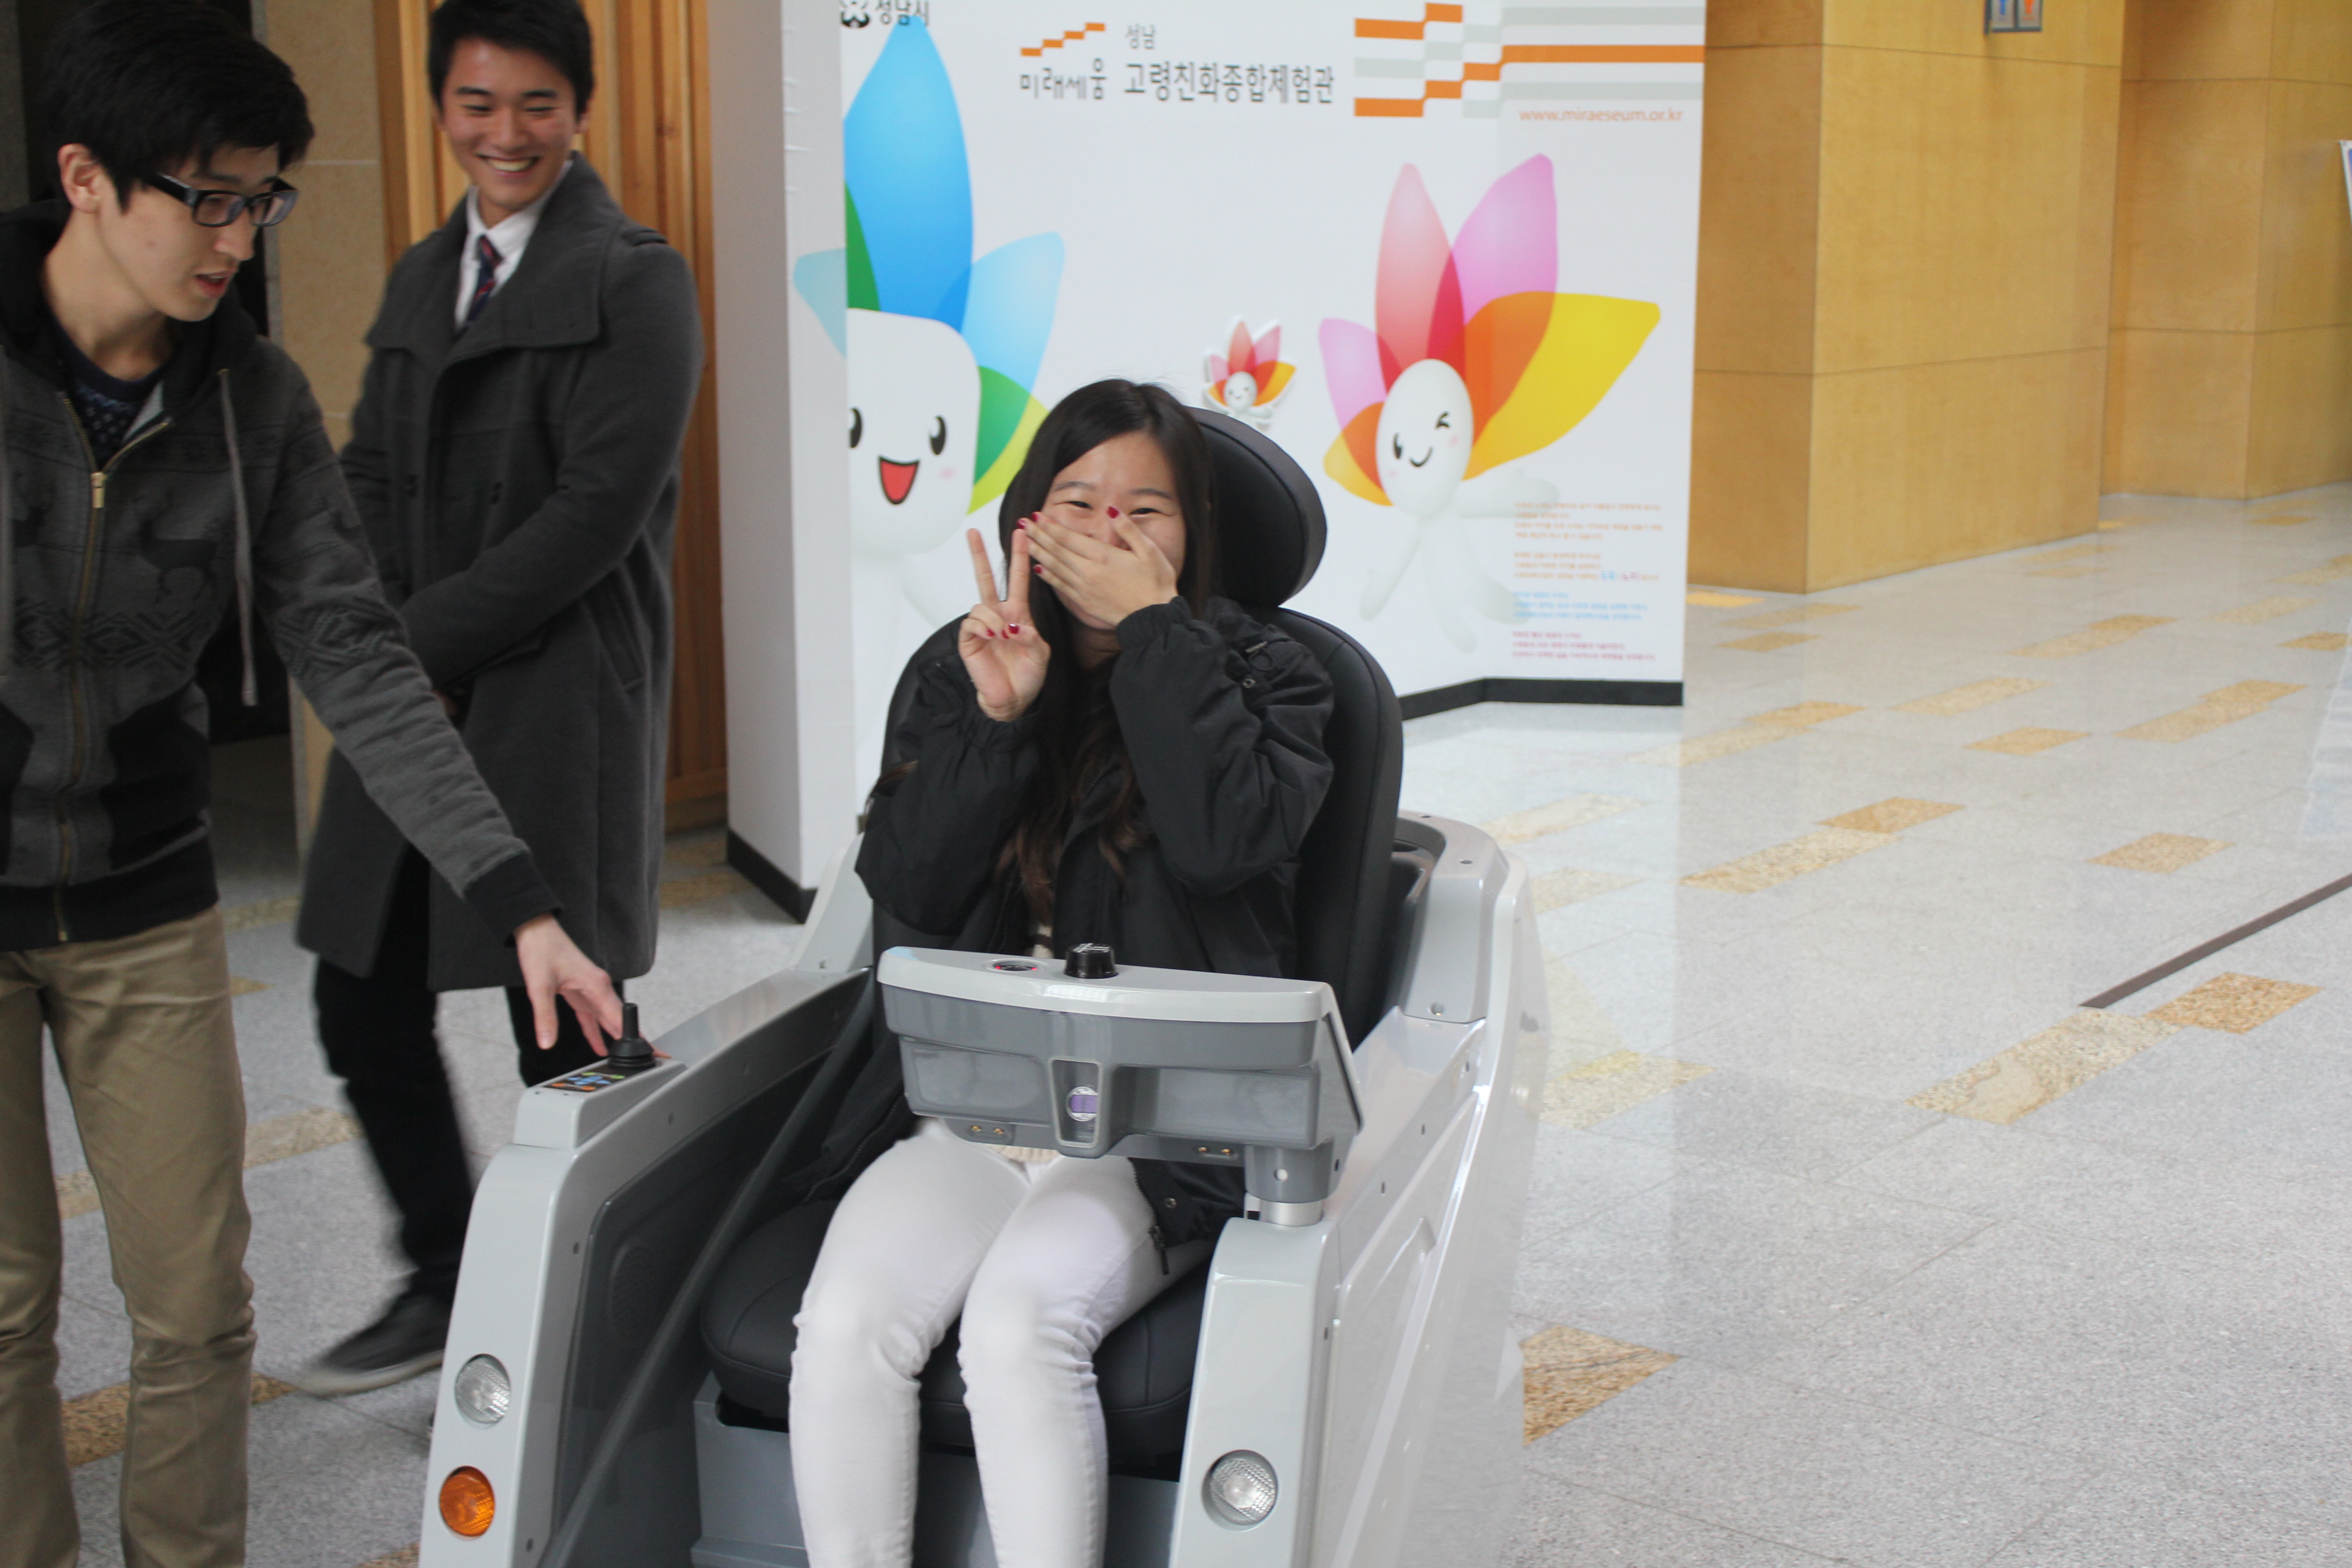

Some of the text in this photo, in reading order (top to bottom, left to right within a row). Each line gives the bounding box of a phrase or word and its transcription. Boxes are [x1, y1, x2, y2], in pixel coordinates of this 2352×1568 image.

[875, 0, 930, 26] 성남시
[1125, 24, 1157, 49] 성남
[1019, 57, 1107, 99] 미래세움
[1125, 61, 1335, 103] 고령친화종합체험관
[1518, 107, 1683, 122] www.miraeseum.or.kr
